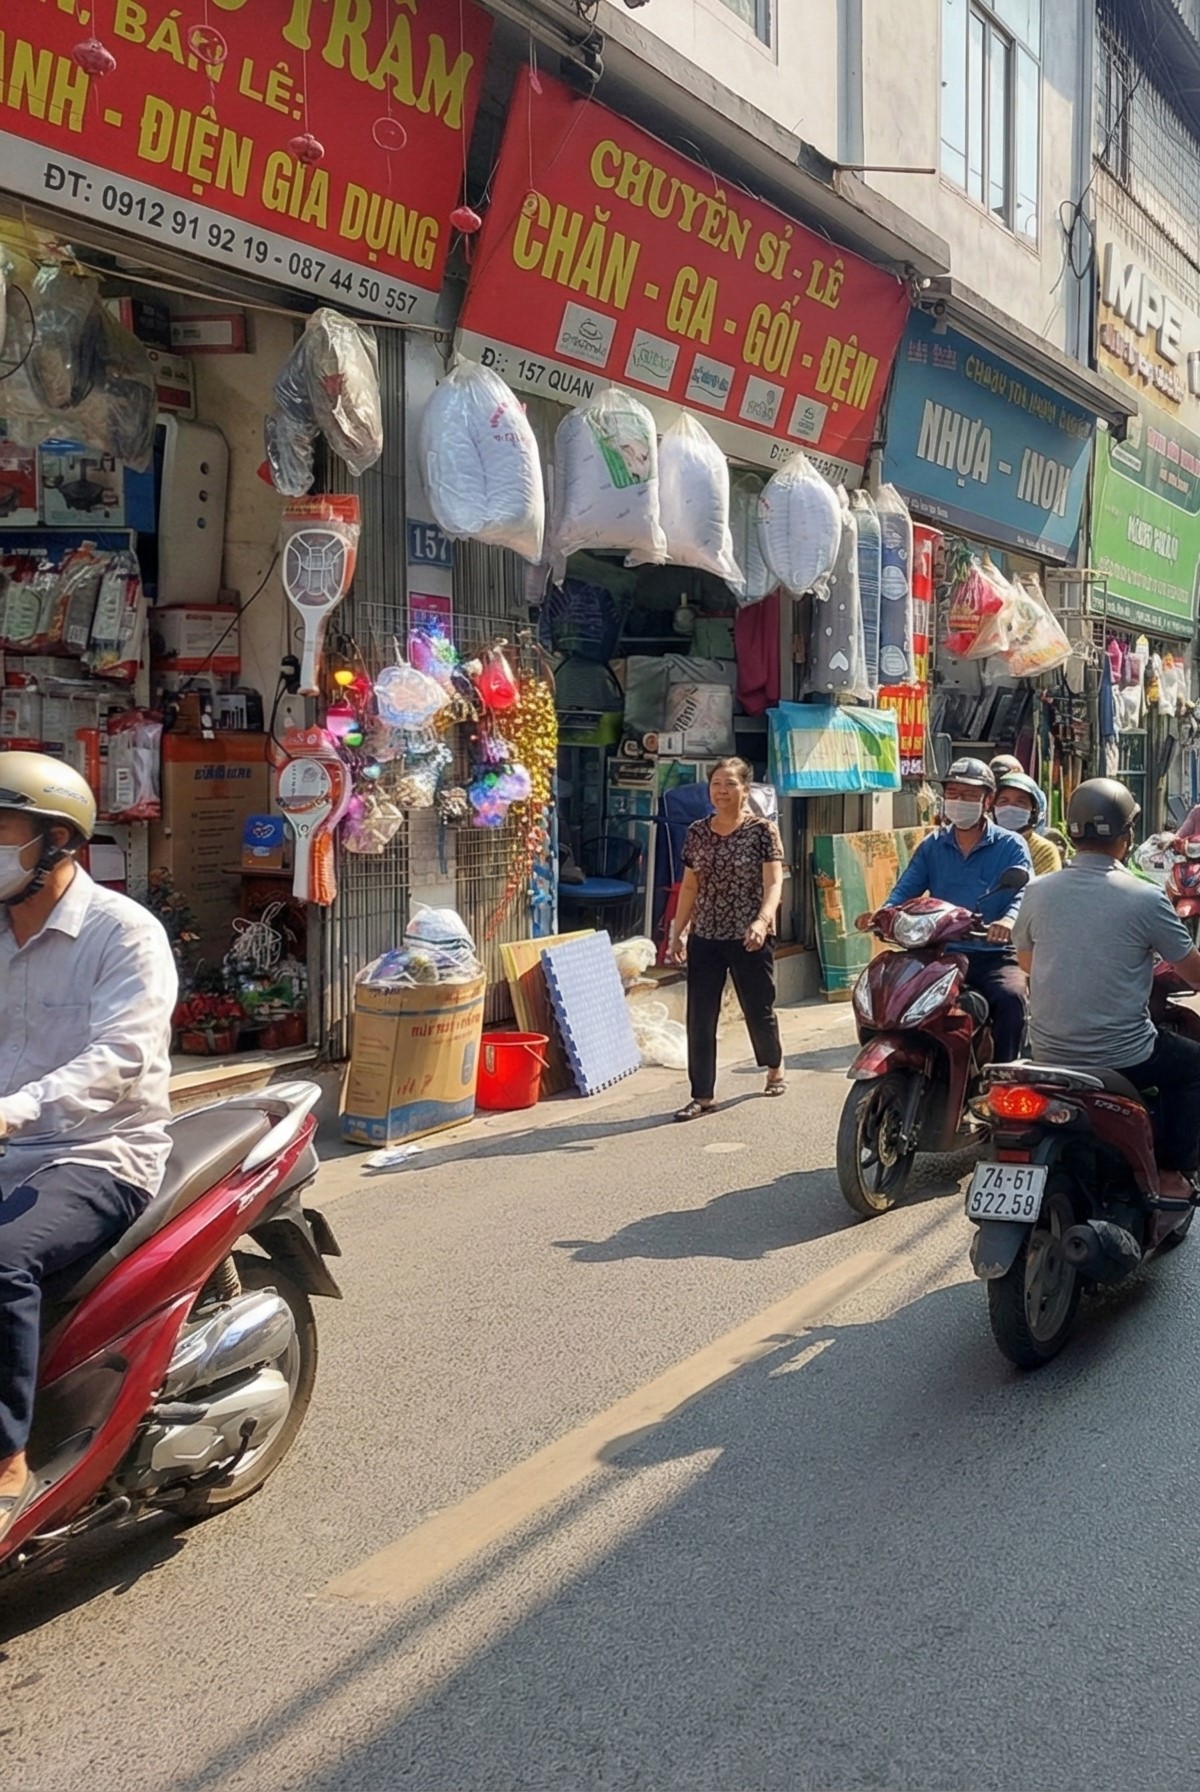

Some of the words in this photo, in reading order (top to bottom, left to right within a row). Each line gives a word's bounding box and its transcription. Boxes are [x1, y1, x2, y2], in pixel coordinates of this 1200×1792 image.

[0, 30, 90, 132] NH
[138, 94, 253, 197] ĐIỆN
[261, 150, 330, 230] GIA
[339, 182, 439, 271] DỤNG
[590, 140, 752, 260] CHUYÊN
[44, 163, 92, 202] ĐT:
[102, 185, 164, 227] 0912
[171, 210, 199, 240] 91
[207, 223, 236, 252] 92
[243, 236, 268, 264] 19
[288, 252, 325, 283] 087
[329, 269, 353, 294] 44
[358, 278, 379, 303] 50
[385, 288, 418, 314] 557
[513, 191, 641, 310] CHĂN
[666, 265, 718, 345] GA
[742, 294, 801, 378] GỐI
[814, 334, 879, 412] ĐỆM
[518, 359, 546, 383] 157
[548, 369, 595, 399] QUAN
[916, 398, 991, 487] NHỰA
[413, 526, 447, 560] 157
